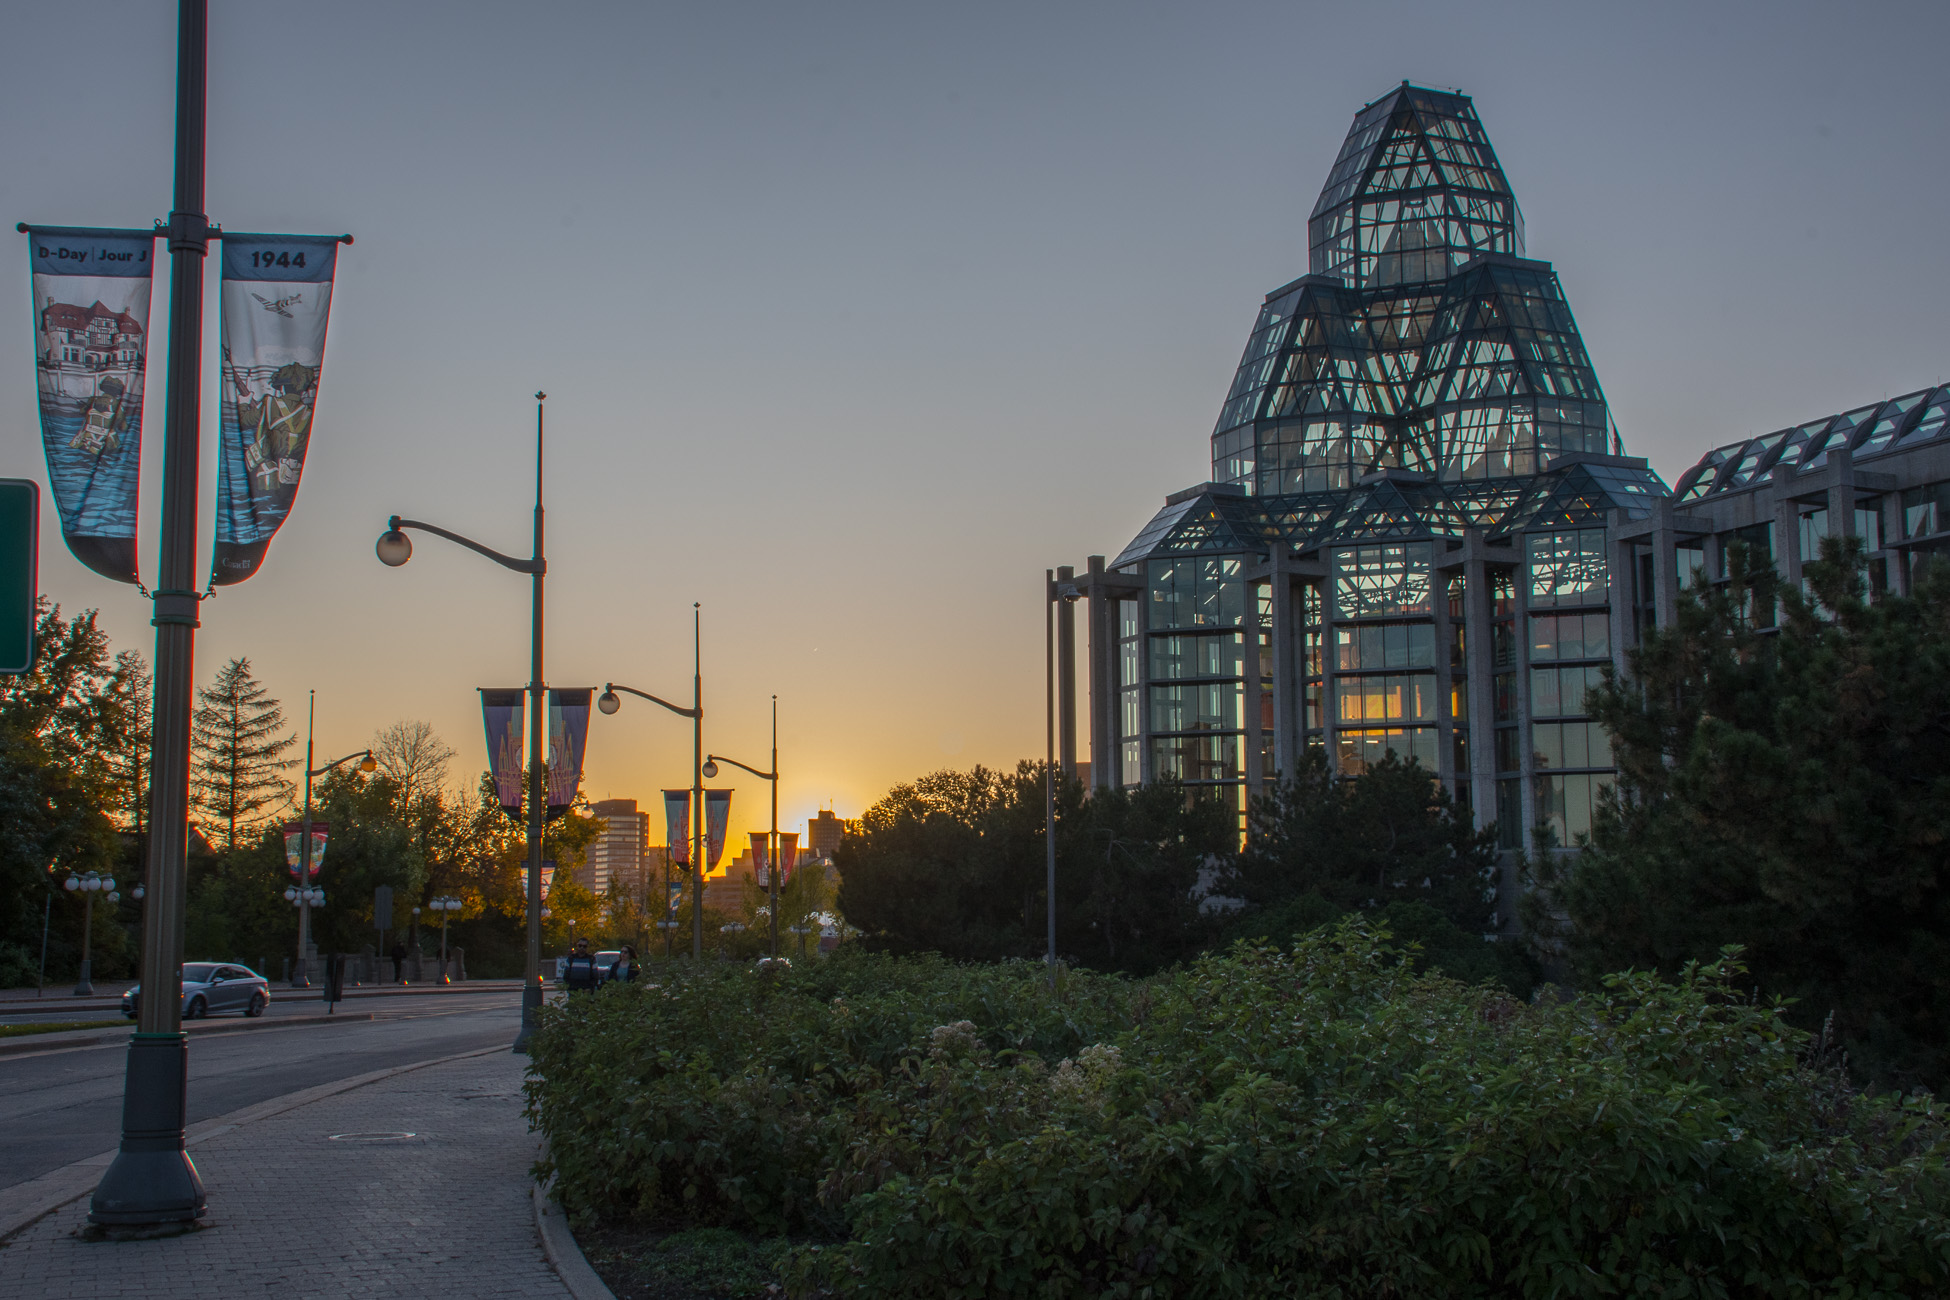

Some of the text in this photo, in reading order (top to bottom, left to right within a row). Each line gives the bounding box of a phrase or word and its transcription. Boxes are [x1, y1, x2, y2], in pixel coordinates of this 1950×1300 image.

[38, 246, 147, 263] D-Day Jour J
[252, 251, 306, 268] 1944
